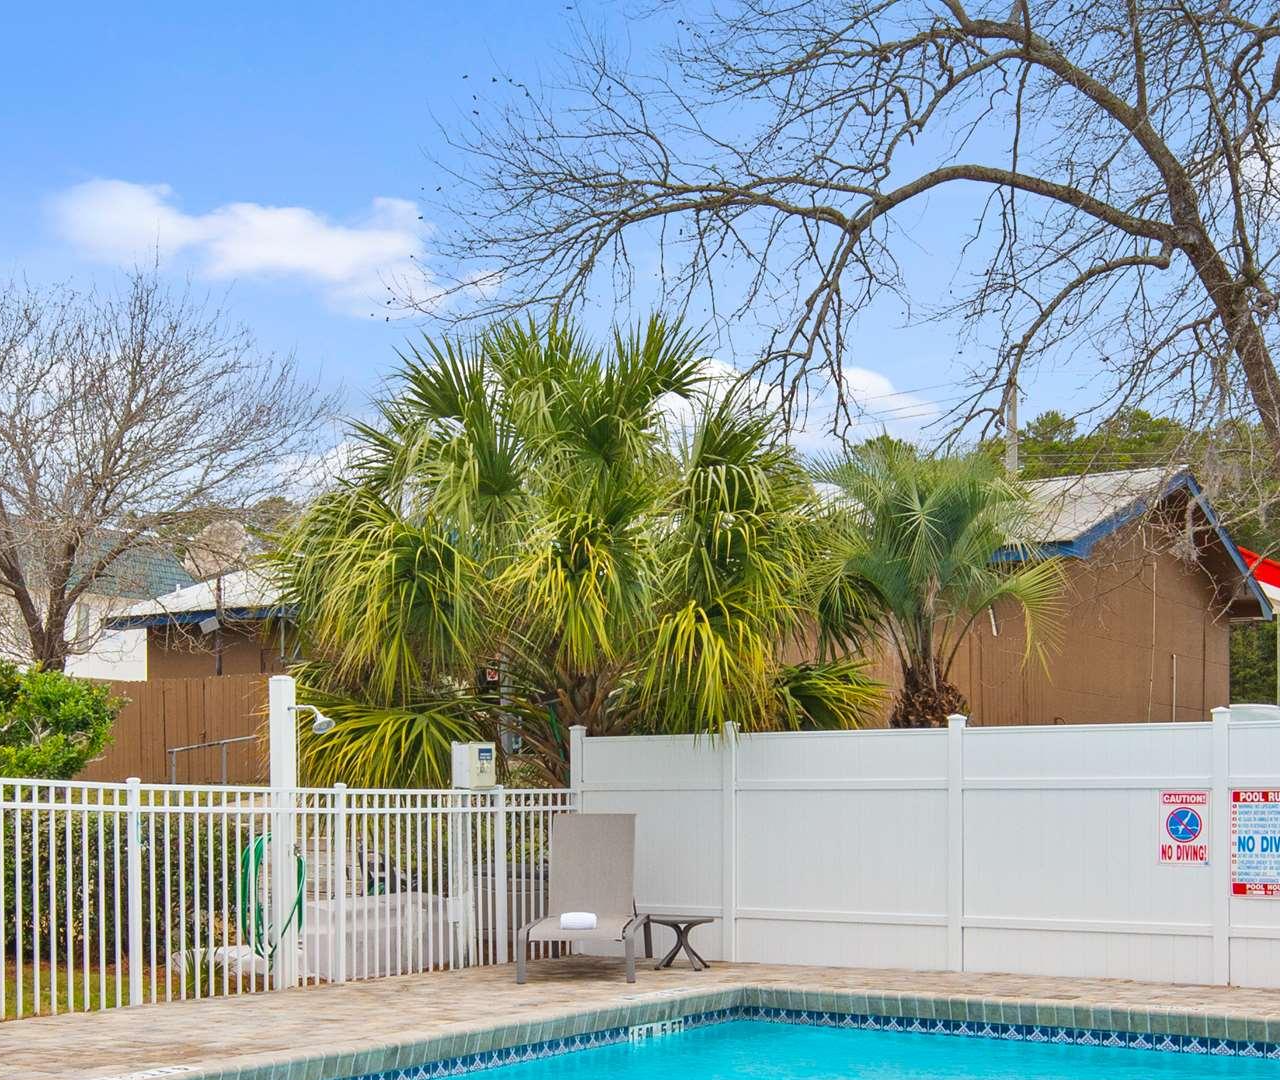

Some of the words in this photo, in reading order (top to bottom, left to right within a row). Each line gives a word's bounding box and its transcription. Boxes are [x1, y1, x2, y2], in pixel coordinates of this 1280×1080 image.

[1163, 794, 1206, 804] CAUTION!
[1240, 792, 1265, 801] POOL
[1237, 835, 1256, 853] NO
[1161, 844, 1173, 861] NO
[1176, 845, 1207, 861] DIVING!
